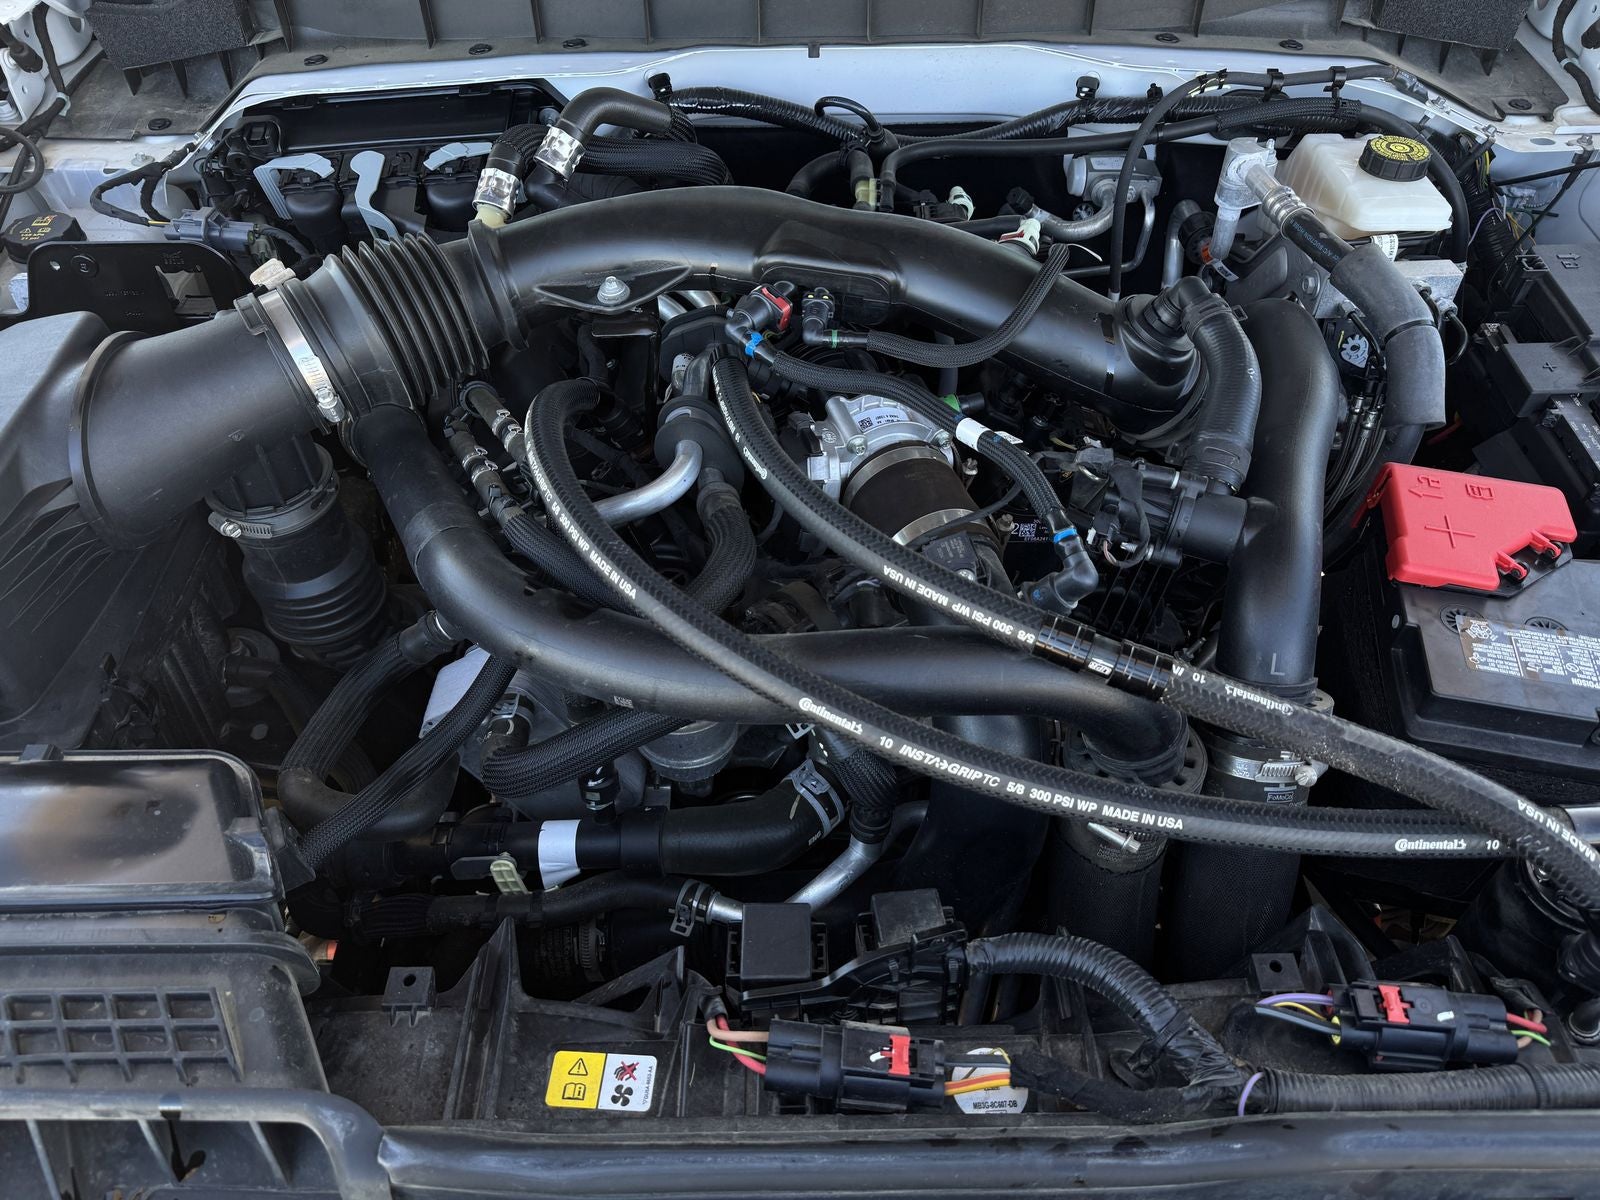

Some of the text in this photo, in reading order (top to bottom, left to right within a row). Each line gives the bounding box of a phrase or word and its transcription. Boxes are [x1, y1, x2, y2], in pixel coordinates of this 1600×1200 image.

[559, 513, 571, 529] 300
[568, 525, 580, 543] PSI
[577, 536, 590, 552] WP
[589, 550, 613, 576] MADE
[609, 570, 621, 584] IN
[618, 579, 637, 600] USA
[883, 564, 1037, 645] 5/8 300 PSI WP MADE IN USA
[1192, 672, 1207, 684] 10
[879, 735, 894, 750] 10
[1006, 781, 1026, 796] 5/8
[1029, 787, 1052, 804] 300
[1052, 794, 1075, 809] PSI
[1076, 799, 1099, 814] WP
[1101, 804, 1140, 824] MADE
[1141, 812, 1156, 827] IN
[1156, 816, 1184, 831] USA
[1485, 839, 1500, 851] 10
[1517, 799, 1596, 863] MADE IN USA
